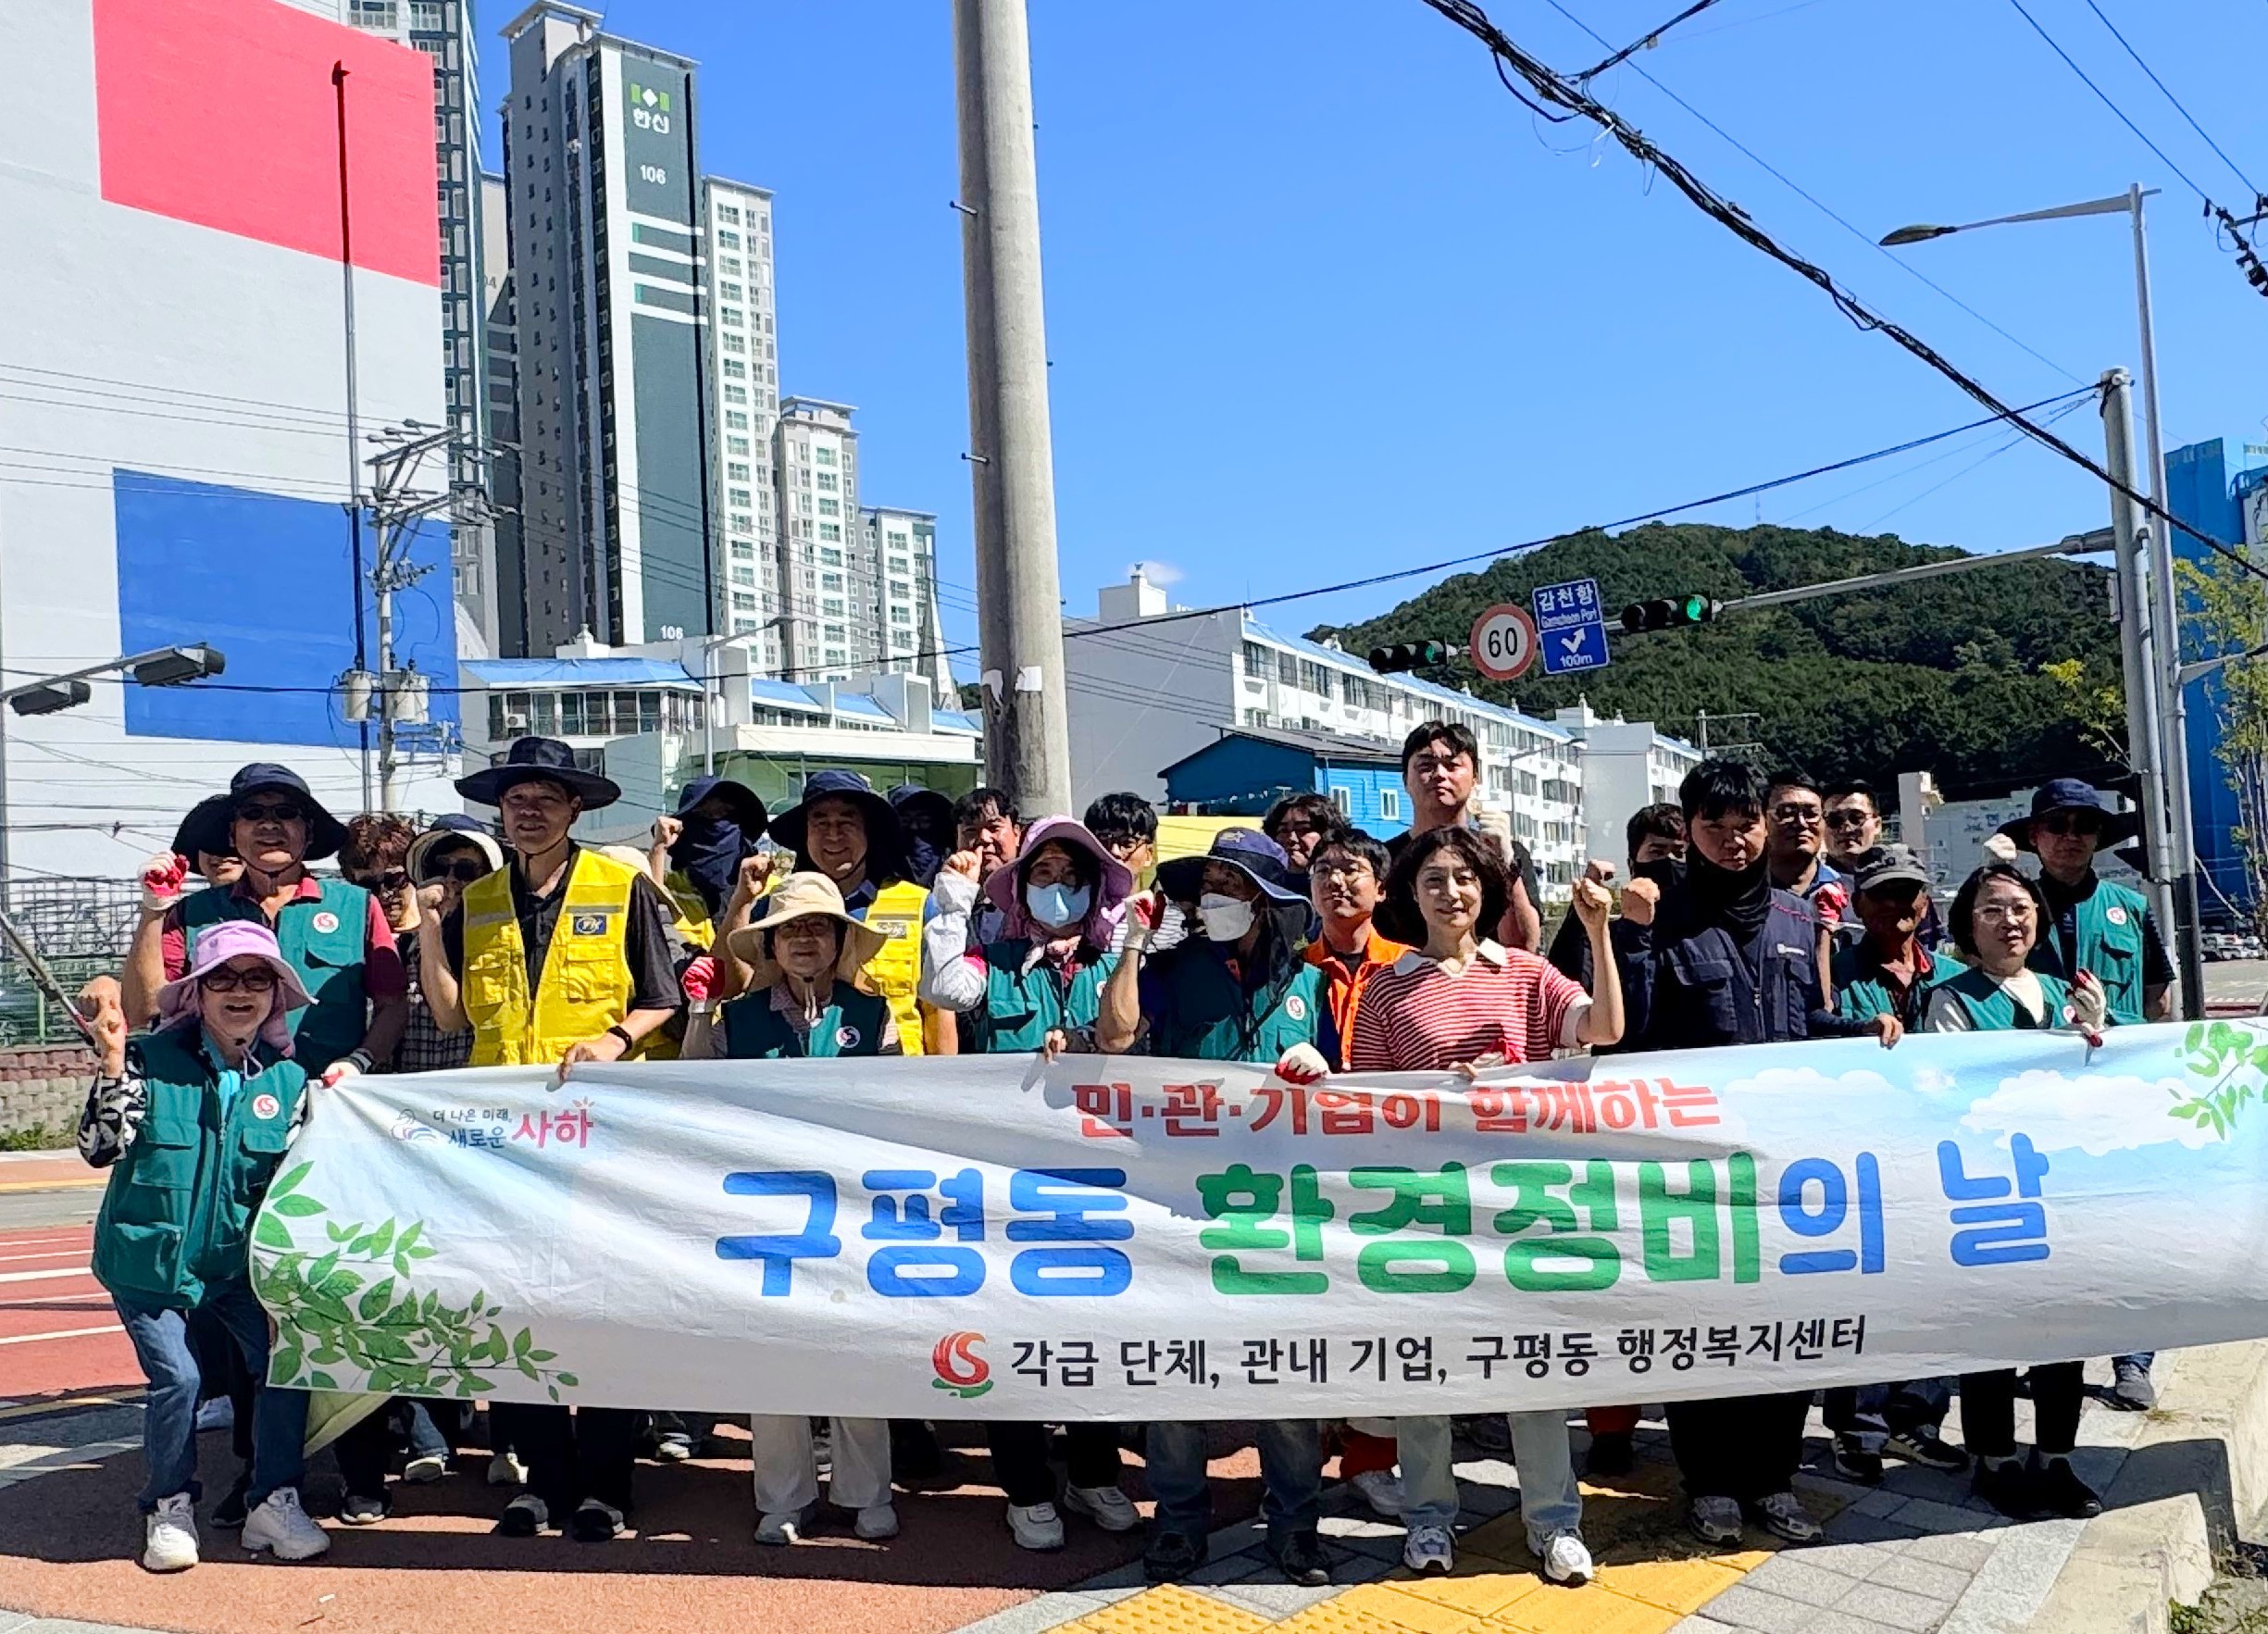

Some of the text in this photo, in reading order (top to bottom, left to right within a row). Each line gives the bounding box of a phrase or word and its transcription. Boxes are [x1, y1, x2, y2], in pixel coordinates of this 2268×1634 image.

[640, 164, 667, 185] 106
[1539, 584, 1593, 612] 감천항
[1489, 627, 1518, 658] 60
[1560, 655, 1593, 667] 100m
[433, 1109, 445, 1122] 더
[450, 1109, 477, 1123] 나은
[1470, 1078, 1721, 1134] 함께하는
[448, 1107, 594, 1149] 새로운 사하
[715, 1132, 2050, 1297] 구평동 환경정비의 날
[1011, 1314, 1867, 1389] 각급 단체, 관내 기업, 구평동 행정복지센터
